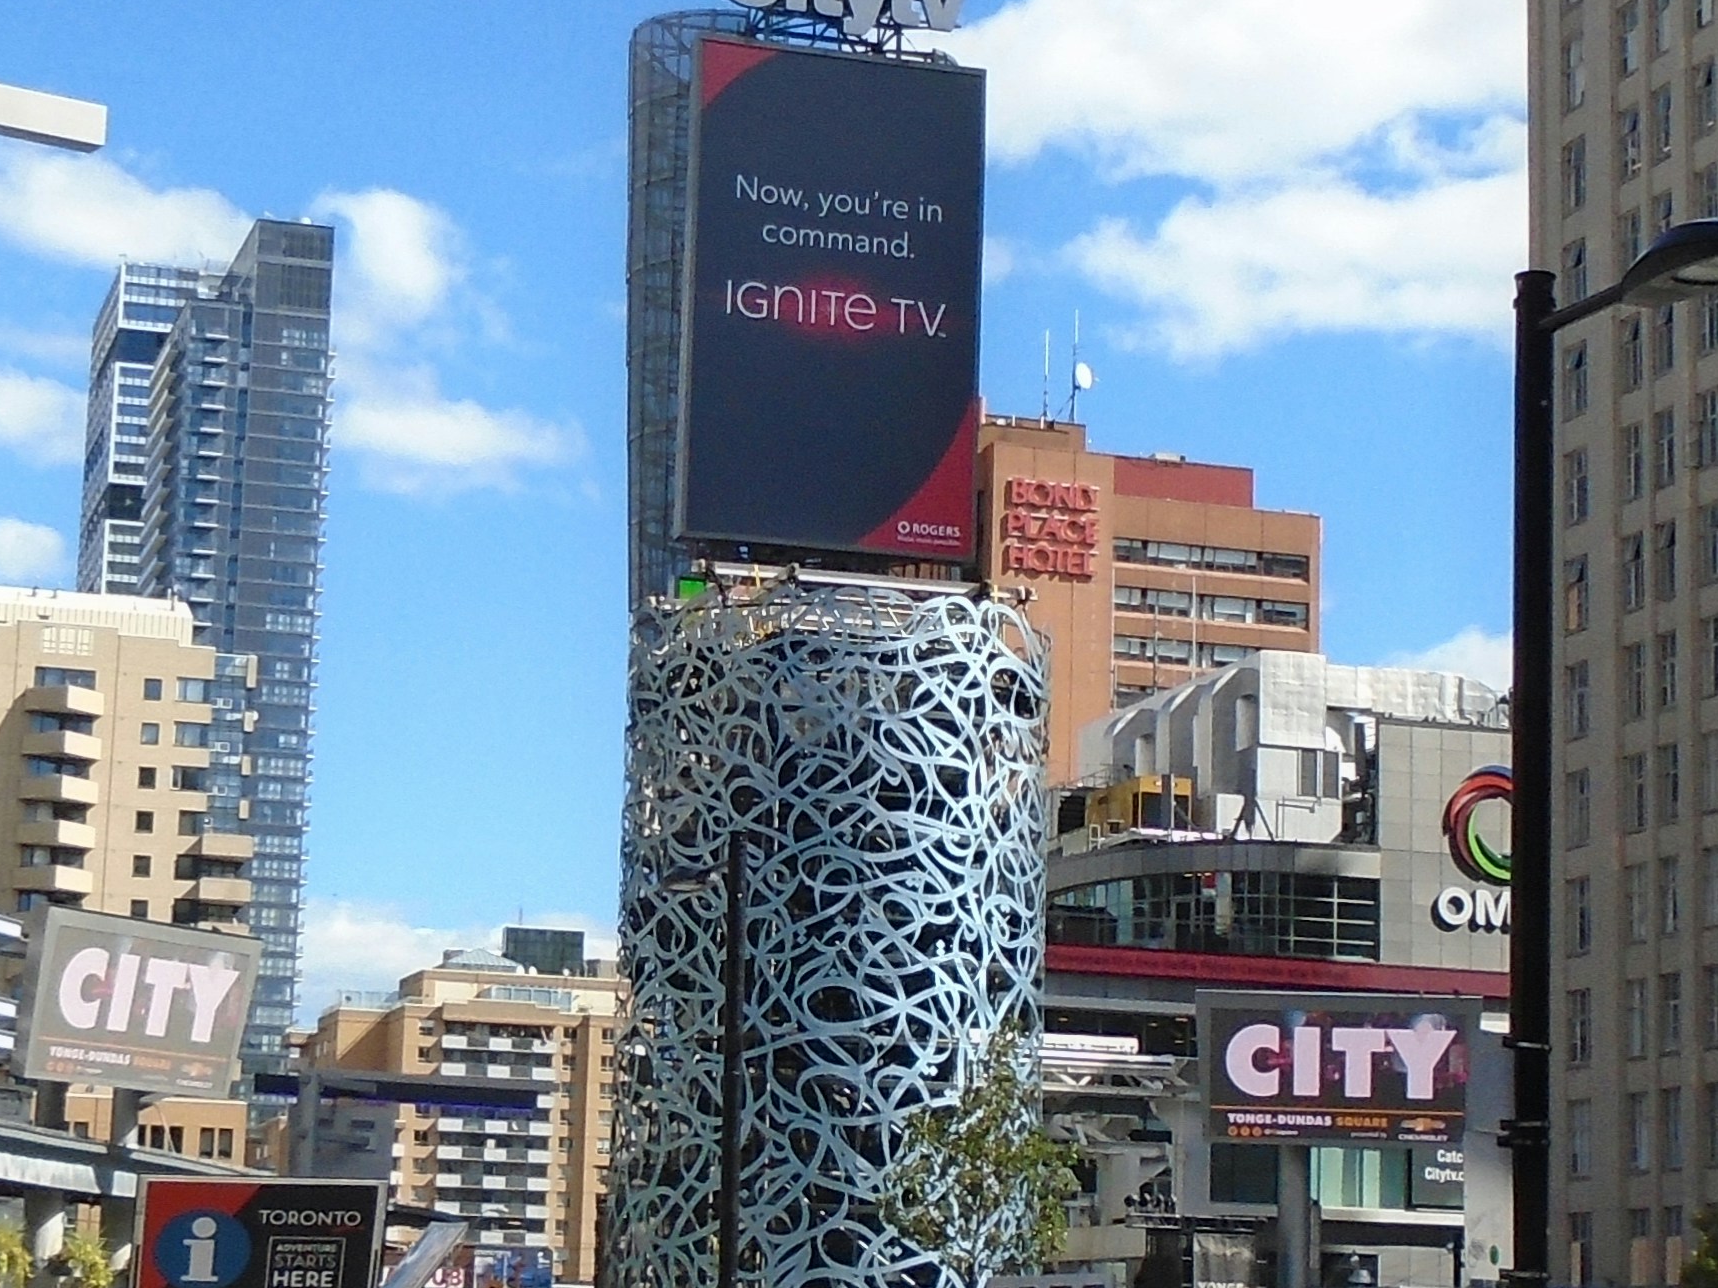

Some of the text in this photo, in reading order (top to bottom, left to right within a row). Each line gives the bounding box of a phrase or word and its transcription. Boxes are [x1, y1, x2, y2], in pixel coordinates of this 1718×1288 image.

[735, 174, 943, 223] Now, you're in
[762, 224, 915, 259] command.
[890, 297, 947, 338] TV
[1010, 477, 1100, 511] BOND
[912, 522, 961, 538] ROGERS
[1007, 511, 1100, 545] PLACE
[1009, 544, 1099, 577] HOTEL
[59, 947, 241, 1043] CITY
[1225, 1023, 1458, 1100] CITY
[1227, 1112, 1389, 1128] YONGE-DUNDAS SQUARE
[259, 1209, 362, 1227] TORONTO
[274, 1253, 336, 1270] STARTS
[276, 1243, 338, 1253] ADVENTURE
[272, 1270, 334, 1288] HERE
